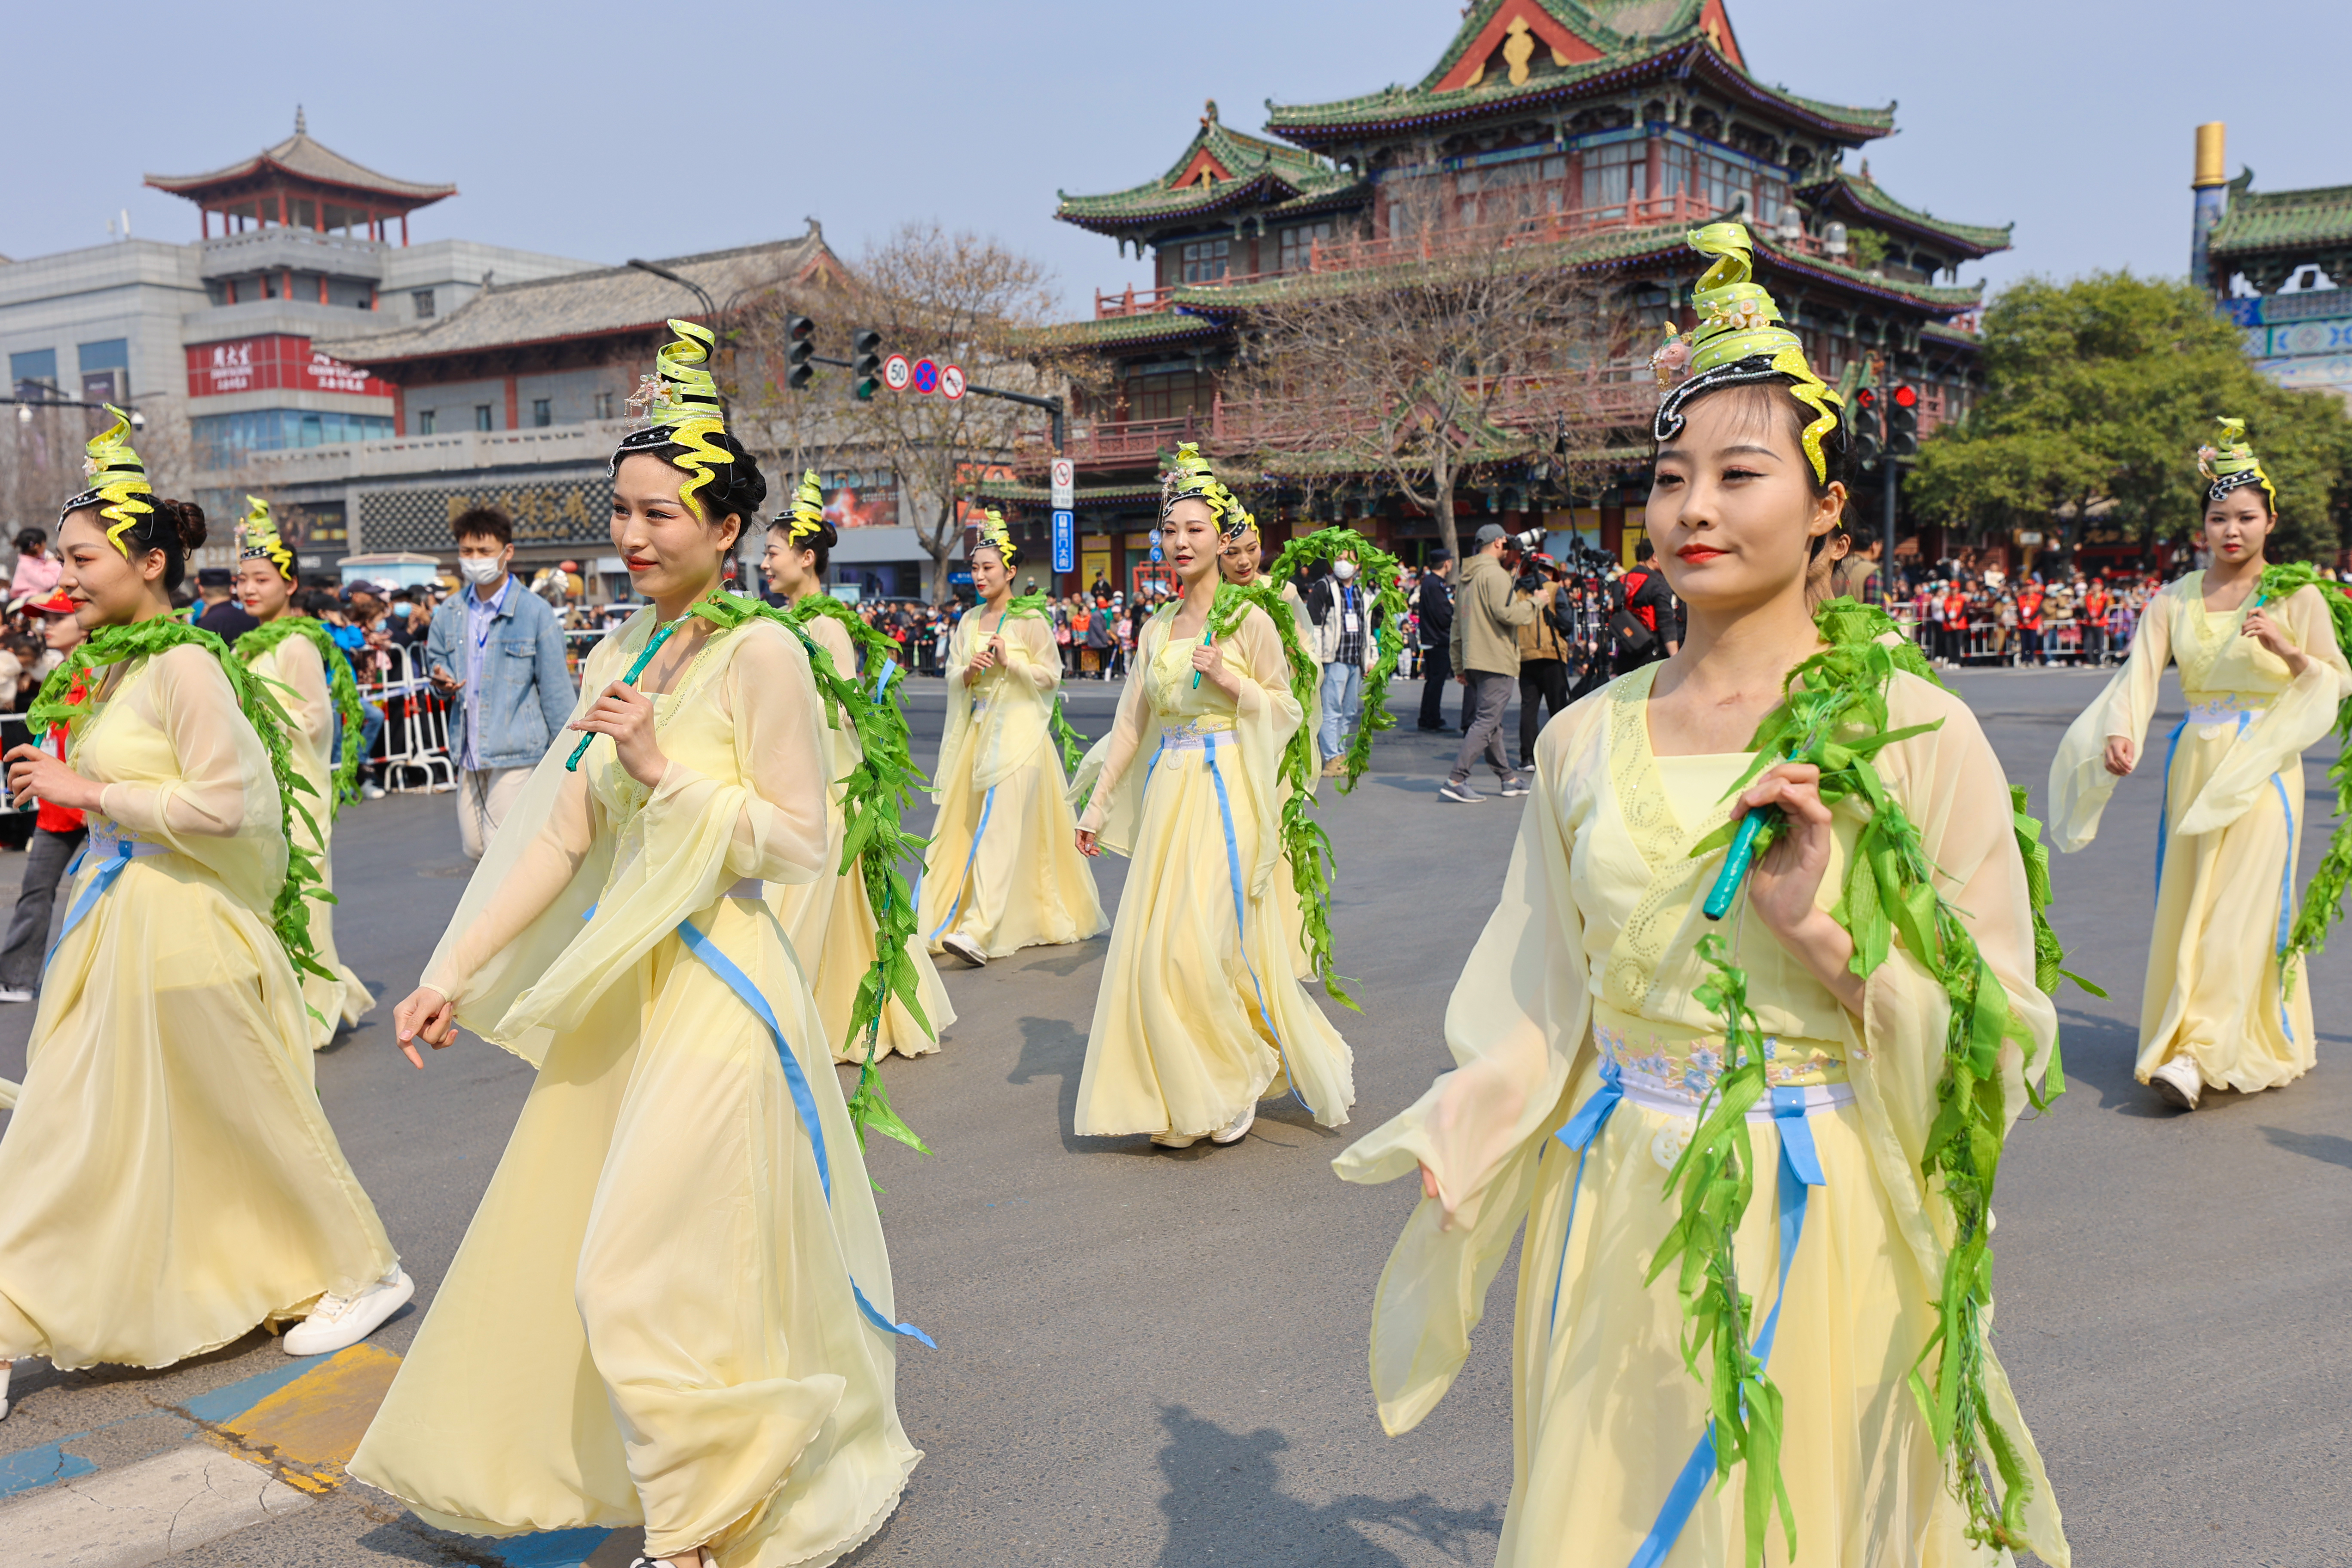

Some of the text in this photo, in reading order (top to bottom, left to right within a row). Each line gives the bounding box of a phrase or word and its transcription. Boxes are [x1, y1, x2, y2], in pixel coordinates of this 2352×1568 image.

[891, 364, 906, 381] 50
[1058, 529, 1069, 567] 西门大街
